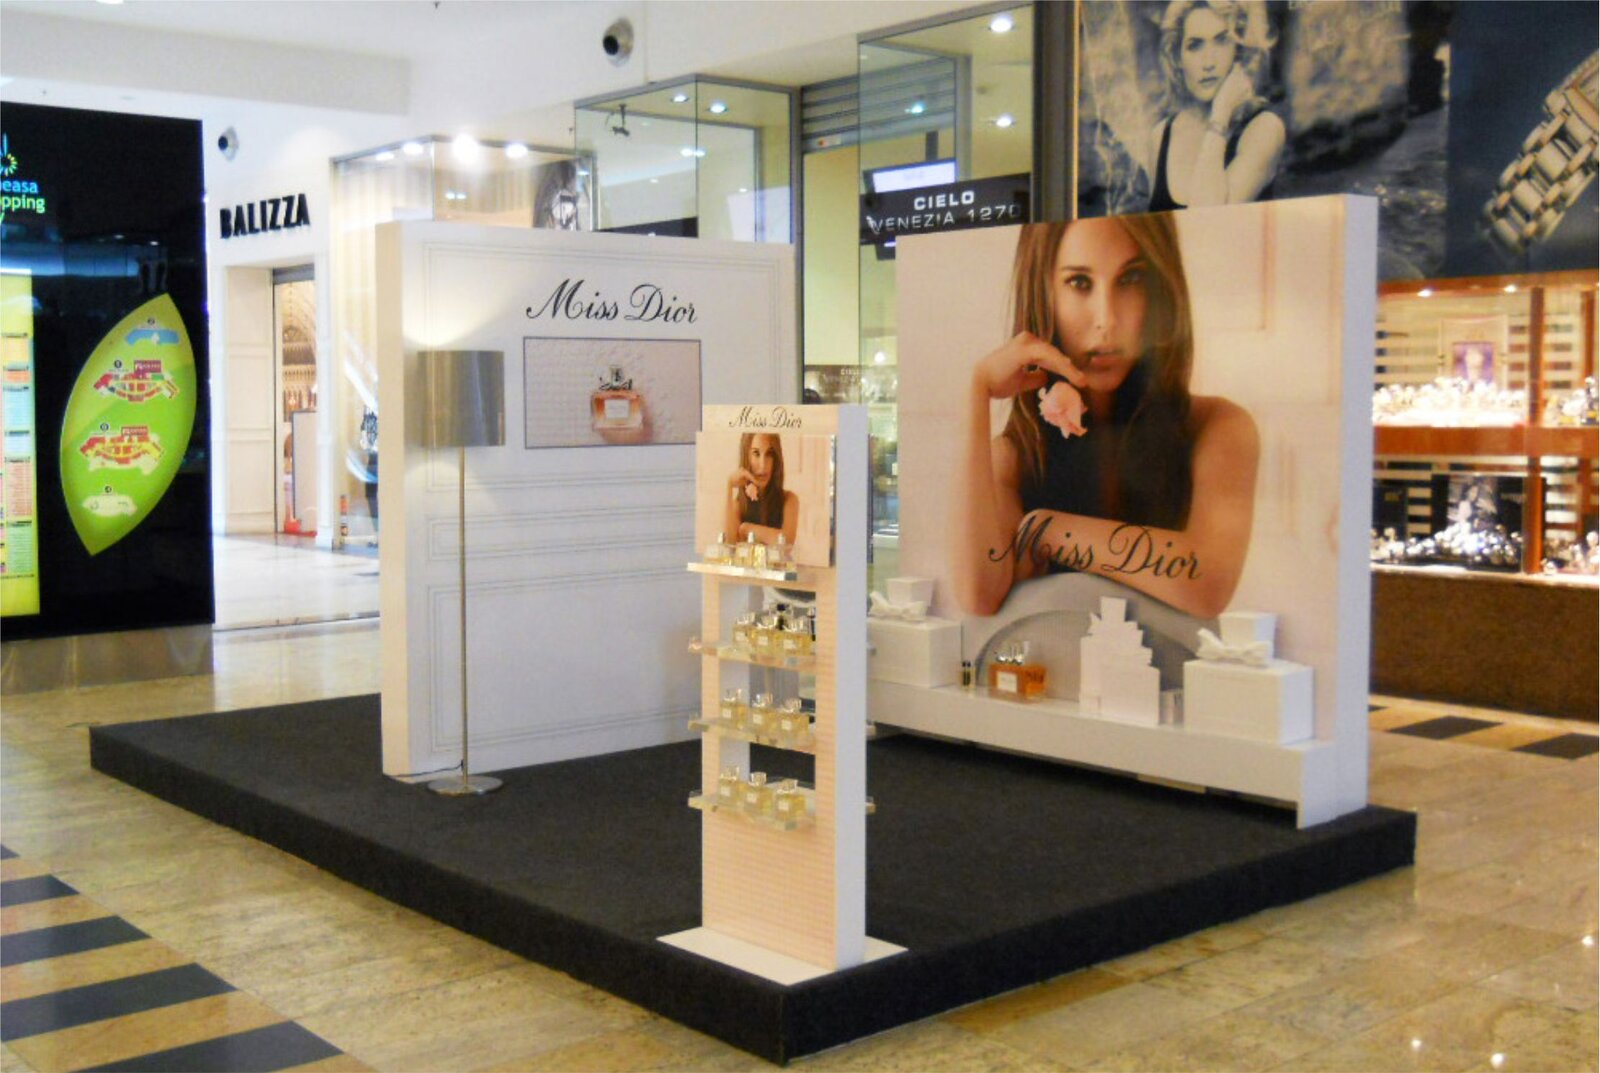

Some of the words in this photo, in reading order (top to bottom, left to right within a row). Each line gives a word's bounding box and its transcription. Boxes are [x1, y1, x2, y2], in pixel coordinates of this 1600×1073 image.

[0, 180, 38, 194] easa
[0, 194, 46, 214] pping
[914, 190, 975, 211] CIELO
[219, 193, 310, 239] BALIZZA
[870, 210, 956, 233] VENEZIA
[526, 277, 619, 321] Miss
[624, 283, 698, 324] Dior
[728, 406, 767, 428] Miss
[769, 406, 802, 429] Dior
[988, 515, 1094, 570] Miss
[1101, 524, 1202, 580] Dior
